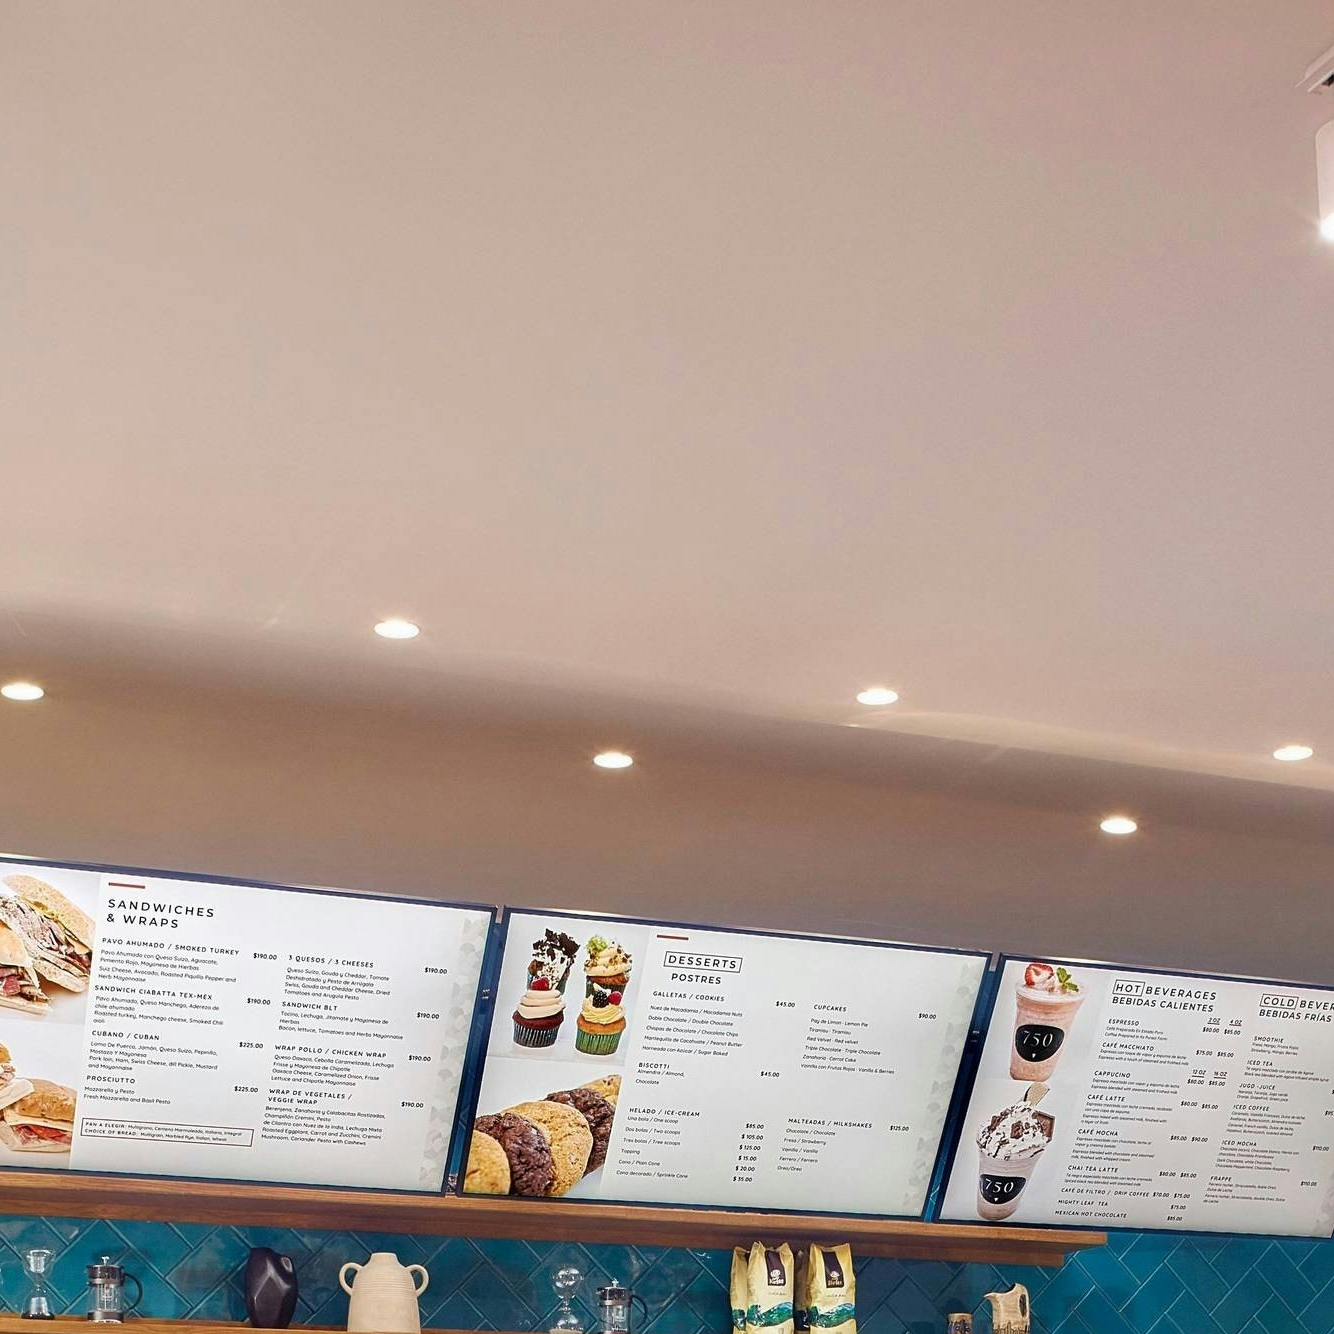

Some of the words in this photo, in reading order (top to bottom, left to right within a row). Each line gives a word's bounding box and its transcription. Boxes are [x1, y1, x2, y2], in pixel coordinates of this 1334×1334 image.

[108, 899, 214, 918] SANDWICHES
[107, 913, 114, 922] &
[123, 915, 178, 928] WRAPS
[126, 940, 165, 948] AHUMADO
[175, 944, 207, 952] SMOKED
[253, 952, 277, 960] $190.00
[295, 956, 325, 964] QUESOS
[341, 960, 373, 968] CHEESES
[668, 955, 737, 970] DESSERTS
[671, 973, 721, 984] POSTRES
[95, 985, 135, 993] SANDWICH
[179, 992, 212, 1000] TEX-MEX
[695, 994, 724, 1002] COOKIES
[1115, 983, 1141, 994] HOT
[1146, 986, 1216, 1001] BEVERAGES
[282, 1001, 321, 1009] SANDWICH
[813, 1004, 847, 1012] CUPCAKES
[1112, 996, 1157, 1007] BEBIDAS
[1160, 1000, 1213, 1012] CALIENTES
[1263, 996, 1296, 1008] COLD
[1259, 1009, 1301, 1020] BEBIDAS
[1304, 1012, 1332, 1022] FRÍAS
[1109, 1018, 1139, 1026] ESPRESSO
[92, 1030, 123, 1038] CUBANO
[1021, 1030, 1053, 1048] 750
[1254, 1036, 1283, 1044] SMOOTHIE
[87, 1075, 135, 1084] PROSCIUTTO
[1094, 1070, 1131, 1078] CAPPUCINO
[985, 1178, 1015, 1194] 750
